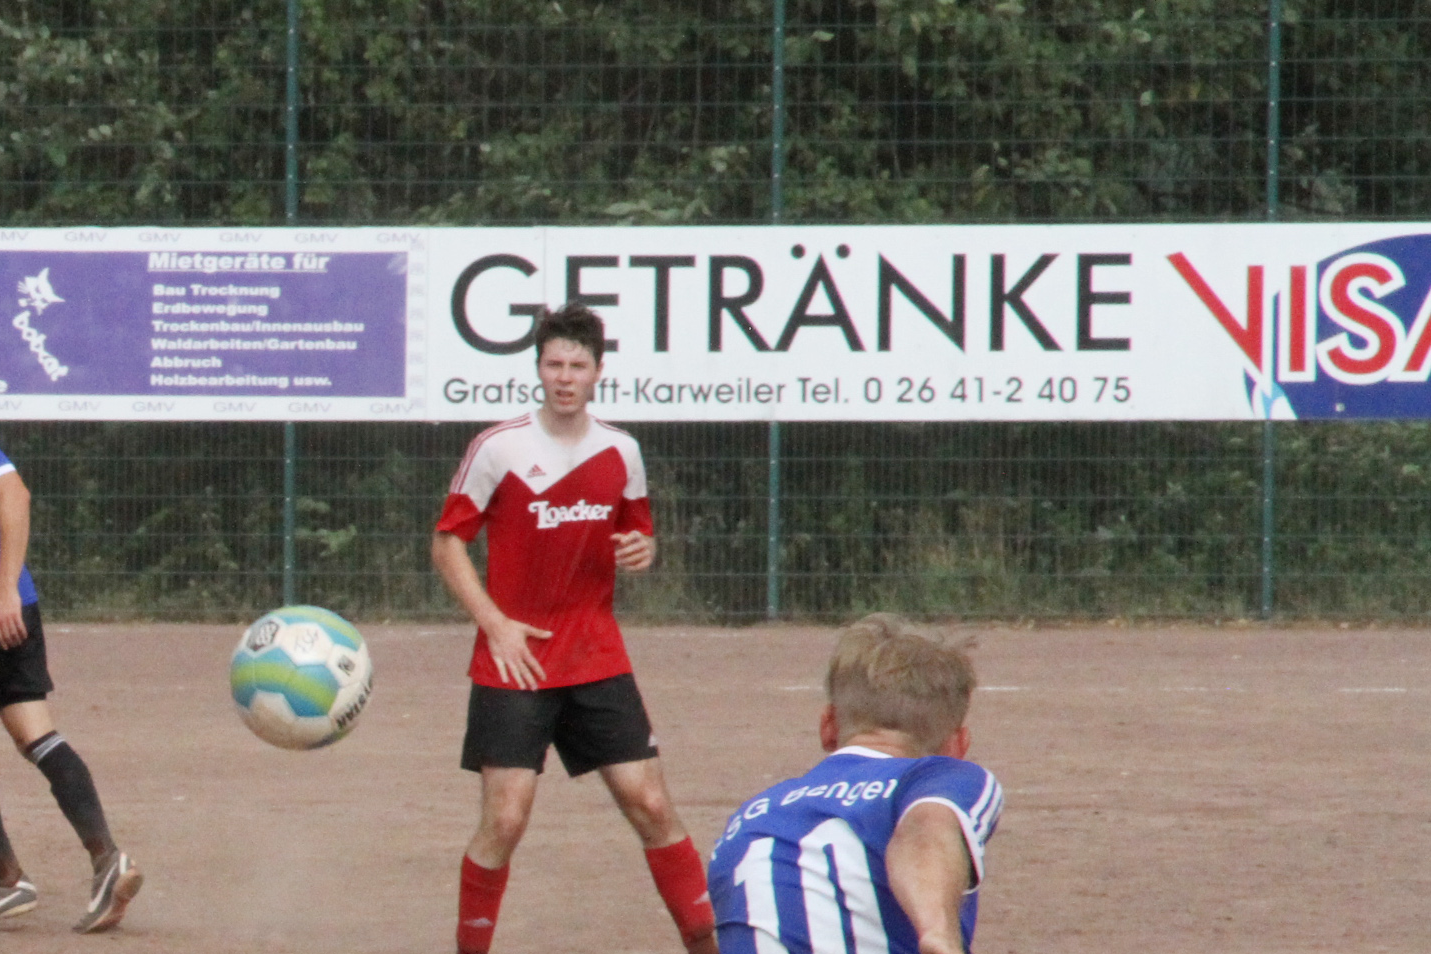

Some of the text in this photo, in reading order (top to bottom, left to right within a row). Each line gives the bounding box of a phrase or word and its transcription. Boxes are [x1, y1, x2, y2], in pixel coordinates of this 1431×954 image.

[64, 232, 107, 242] GMV
[138, 232, 181, 242] GMV
[219, 233, 262, 243] GMV
[294, 233, 338, 243] GMV
[376, 233, 420, 243] GMV
[148, 252, 330, 273] Mietgeräte für
[152, 284, 281, 298] Bau Trocknung
[451, 244, 1132, 355] GETRÄNKE
[152, 302, 269, 316] Erdbewegung
[152, 320, 365, 333] Trockenbau/Innenausbau
[150, 338, 358, 350] Waldarbeiten/Gartenbau
[150, 356, 222, 368] Abbruch
[150, 374, 332, 388] Holzbearbeitung usw.
[443, 376, 1132, 404] Grafscft-Karweiler Tel. 0 26 41-2 40 75
[58, 401, 101, 412] GMV
[132, 401, 175, 412] GMV
[213, 402, 256, 412] GMV
[288, 402, 332, 413] GMV
[369, 403, 414, 414] GMV
[527, 499, 612, 529] Loacker
